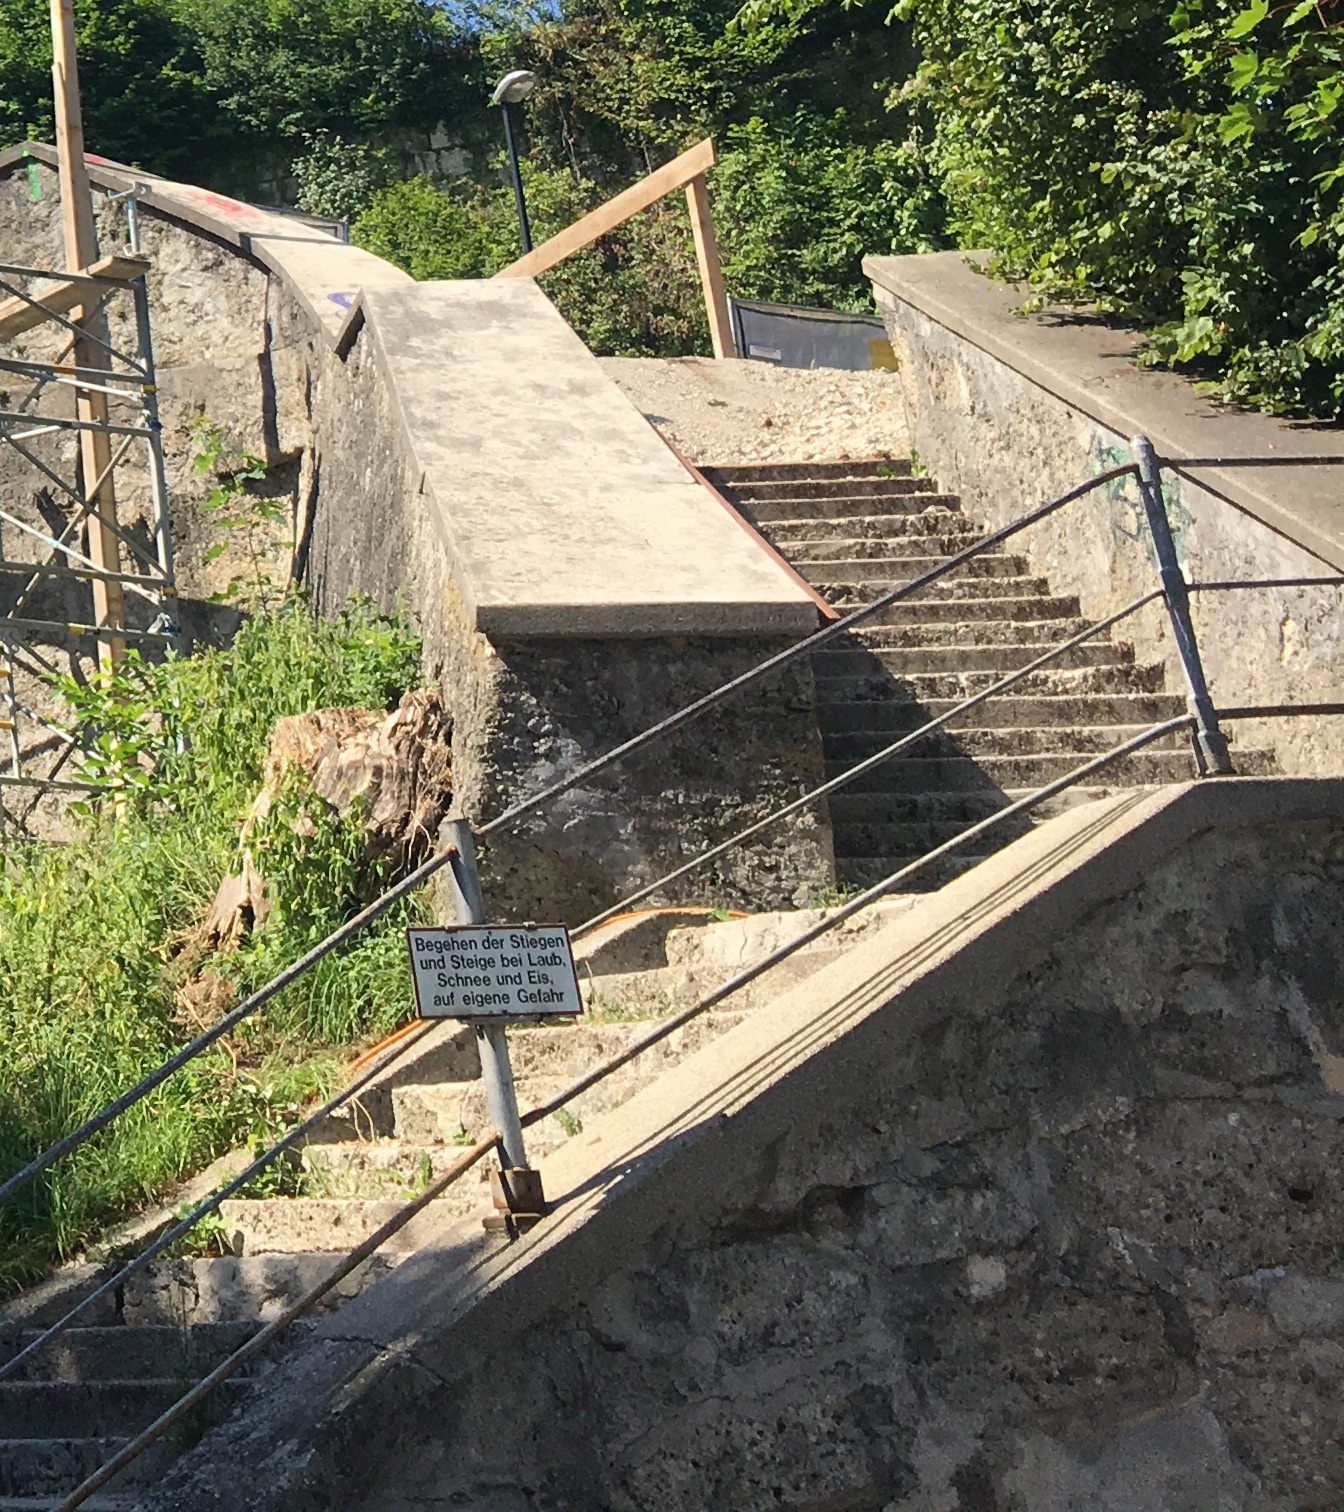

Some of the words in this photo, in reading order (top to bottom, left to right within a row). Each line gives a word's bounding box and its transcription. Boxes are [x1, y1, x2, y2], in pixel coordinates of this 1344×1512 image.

[415, 937, 478, 954] Begehen
[482, 936, 504, 950] der
[509, 934, 565, 950] Stiegen
[420, 956, 446, 970] und
[451, 954, 496, 971] Steige
[500, 953, 523, 968] bei
[528, 952, 566, 968] Laub,
[437, 972, 491, 987] Schnee
[496, 972, 522, 985] und
[528, 970, 554, 985] Eis,
[433, 992, 455, 1006] auf
[462, 992, 510, 1007] eigene
[517, 989, 565, 1004] Gefahr
